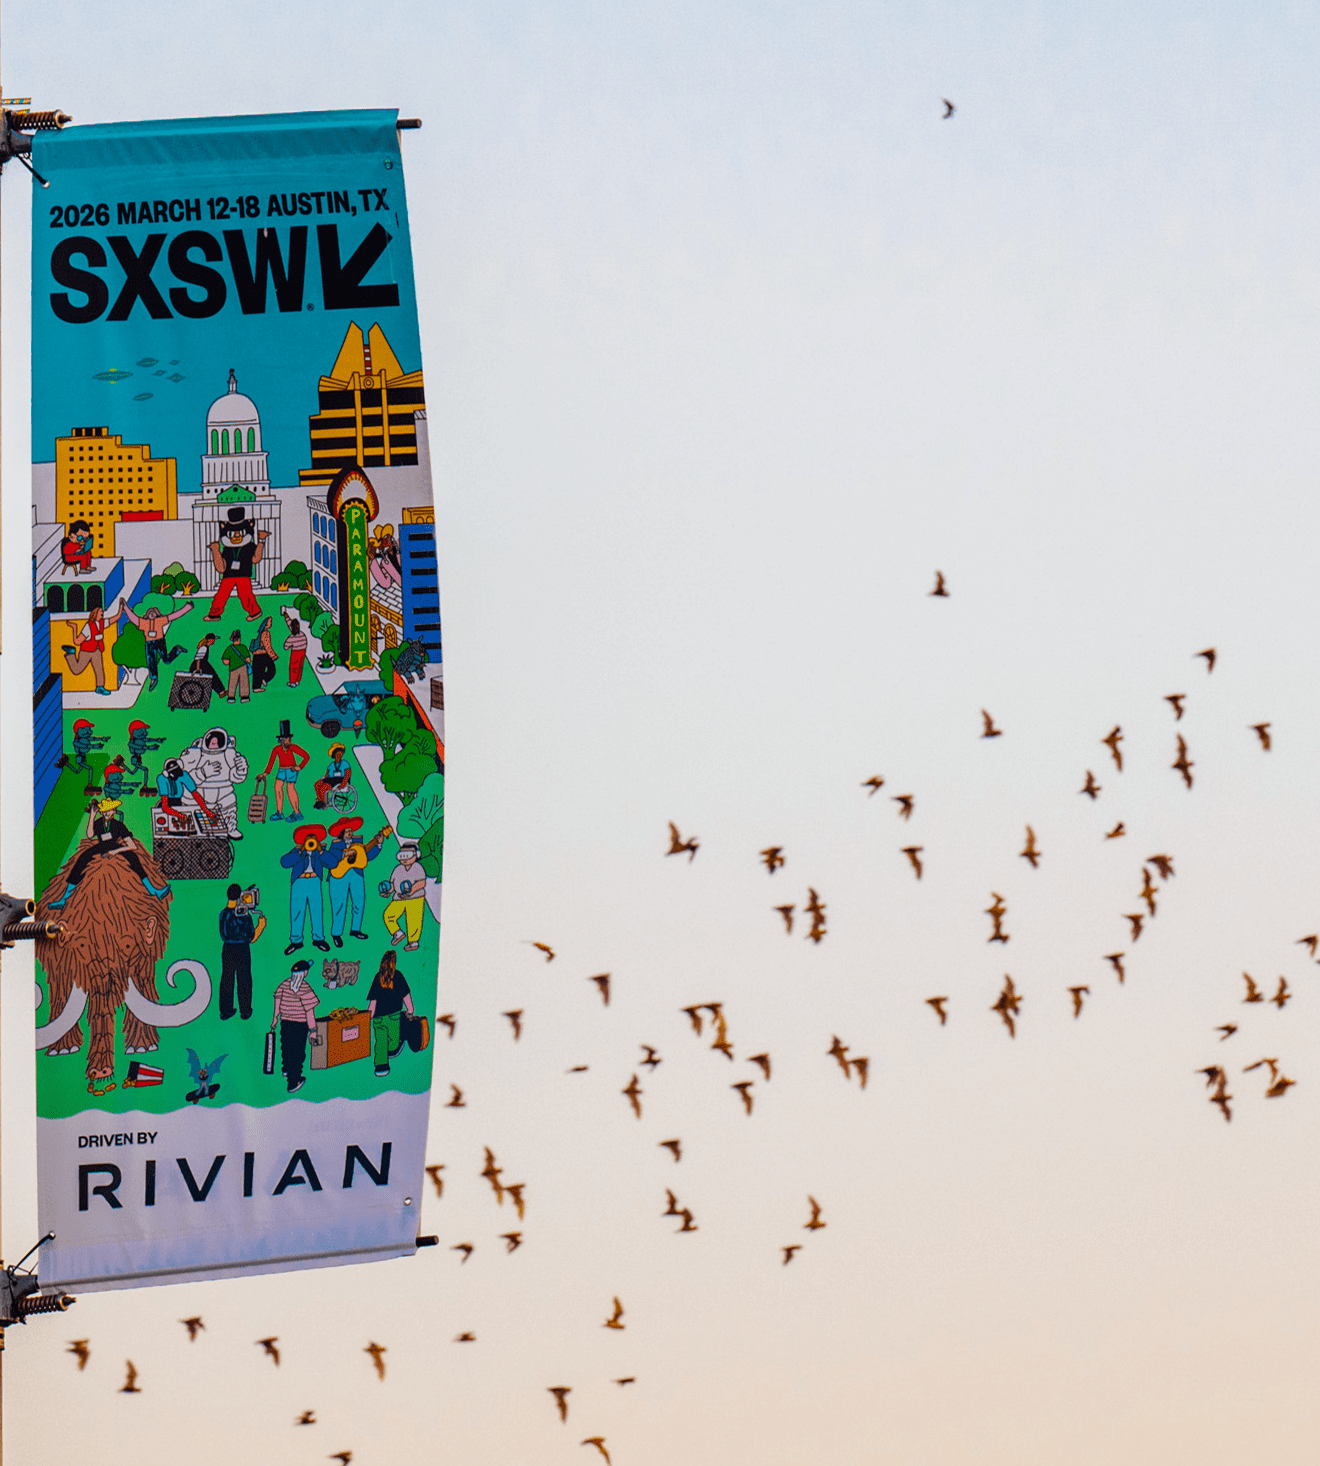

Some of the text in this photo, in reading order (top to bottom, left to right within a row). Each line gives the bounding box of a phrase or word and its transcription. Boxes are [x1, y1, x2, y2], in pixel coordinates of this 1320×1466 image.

[49, 187, 390, 229] 2026 MARCH 12-18 AUSTIN, TX
[49, 225, 309, 325] SXSW
[351, 508, 366, 664] PARAMOUNT
[78, 1131, 158, 1149] DRIVEN BY
[78, 1141, 393, 1212] RIVIAN
